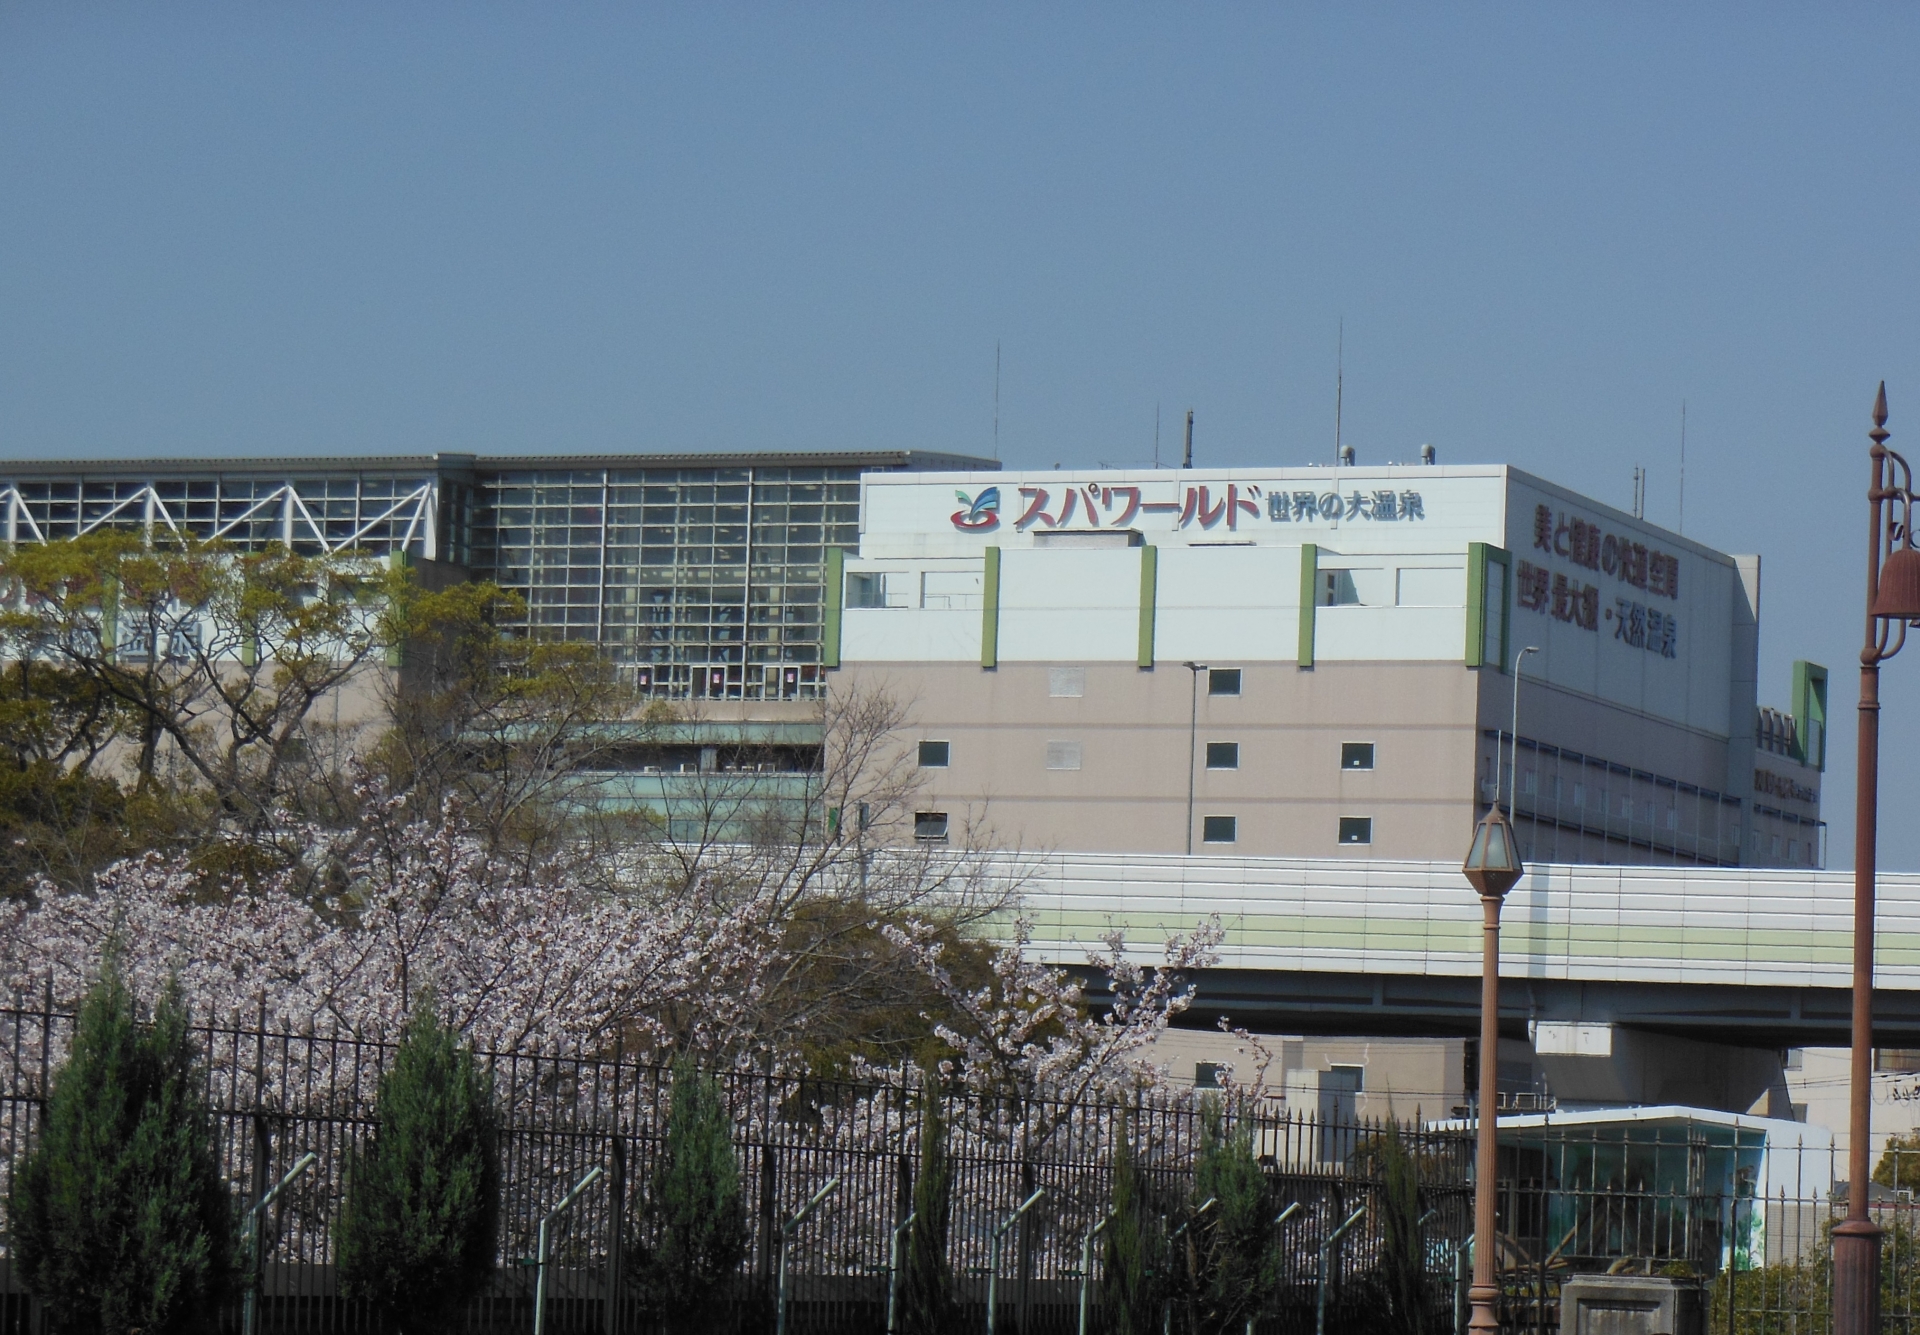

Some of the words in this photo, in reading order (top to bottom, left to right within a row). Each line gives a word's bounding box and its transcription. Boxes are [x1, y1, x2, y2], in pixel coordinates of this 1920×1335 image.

[1013, 482, 1260, 530] スパワールド
[1267, 490, 1425, 522] 世界の大温泉
